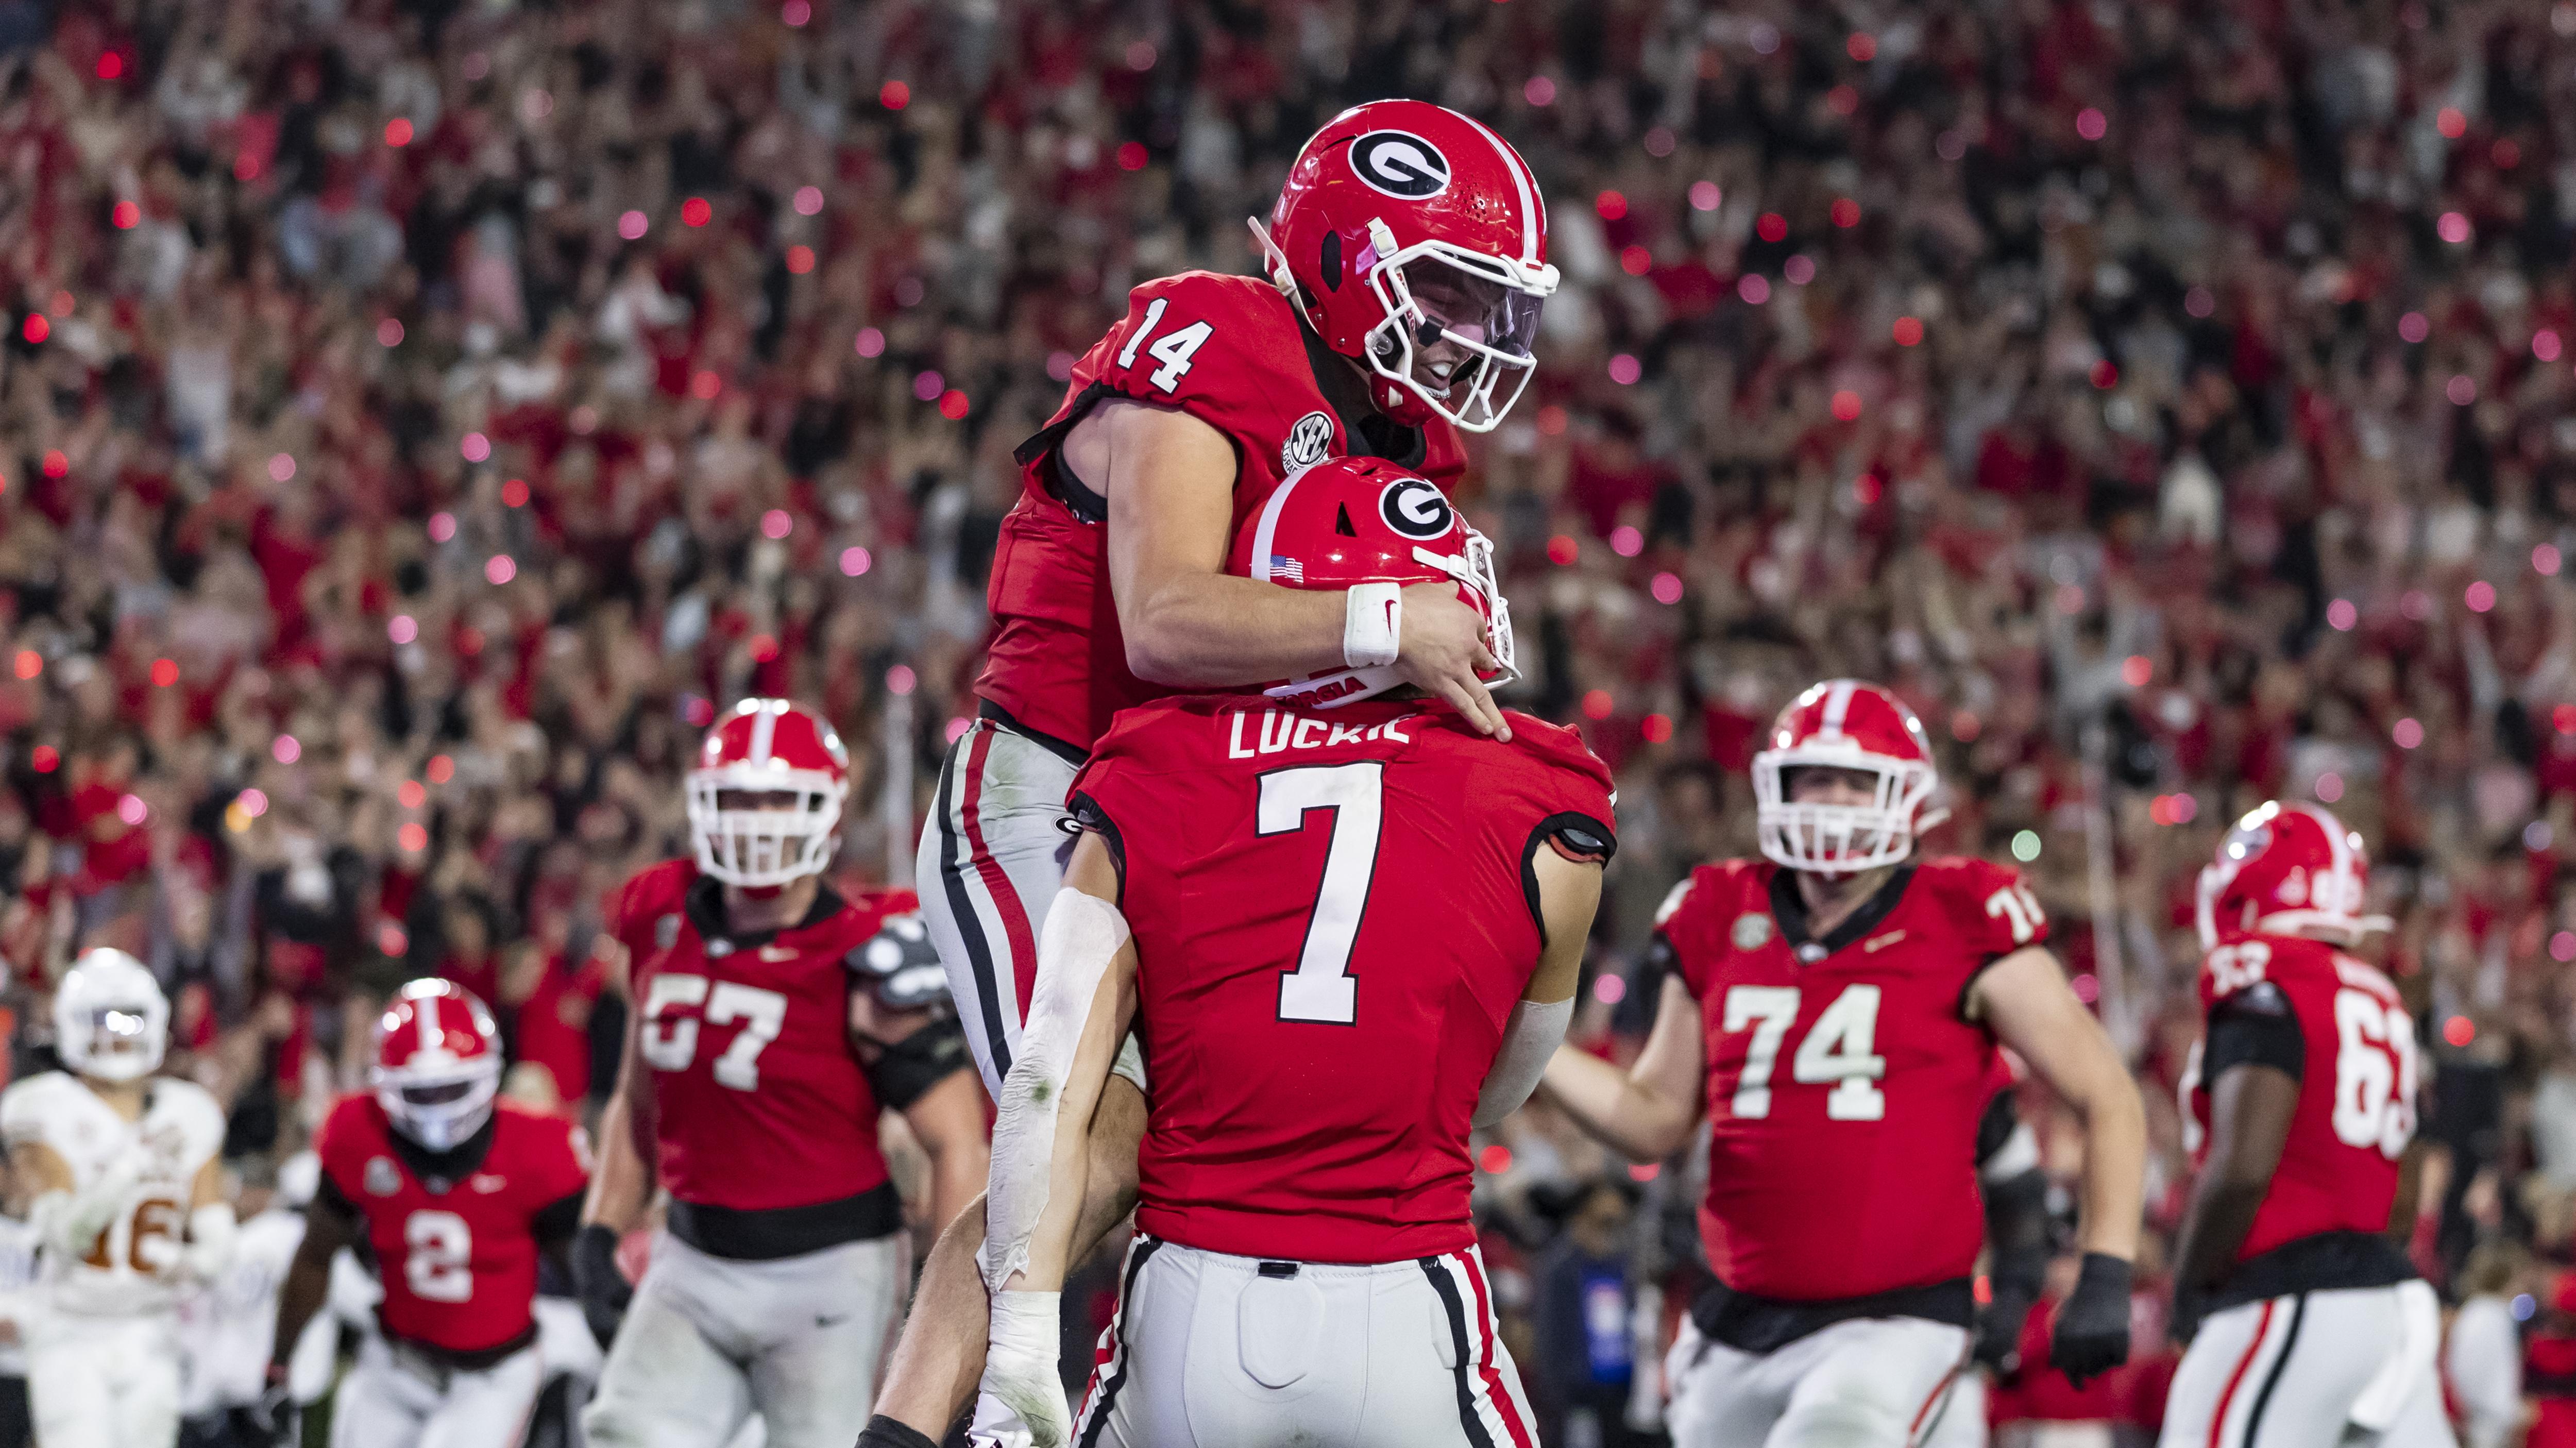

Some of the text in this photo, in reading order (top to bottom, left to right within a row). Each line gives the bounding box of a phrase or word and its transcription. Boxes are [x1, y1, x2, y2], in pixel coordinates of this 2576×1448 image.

[1117, 297, 1216, 394] 14
[1292, 415, 1331, 463] SEC
[1255, 759, 1386, 1027] 7
[1722, 983, 1887, 1121] 74
[403, 1208, 474, 1304] 2
